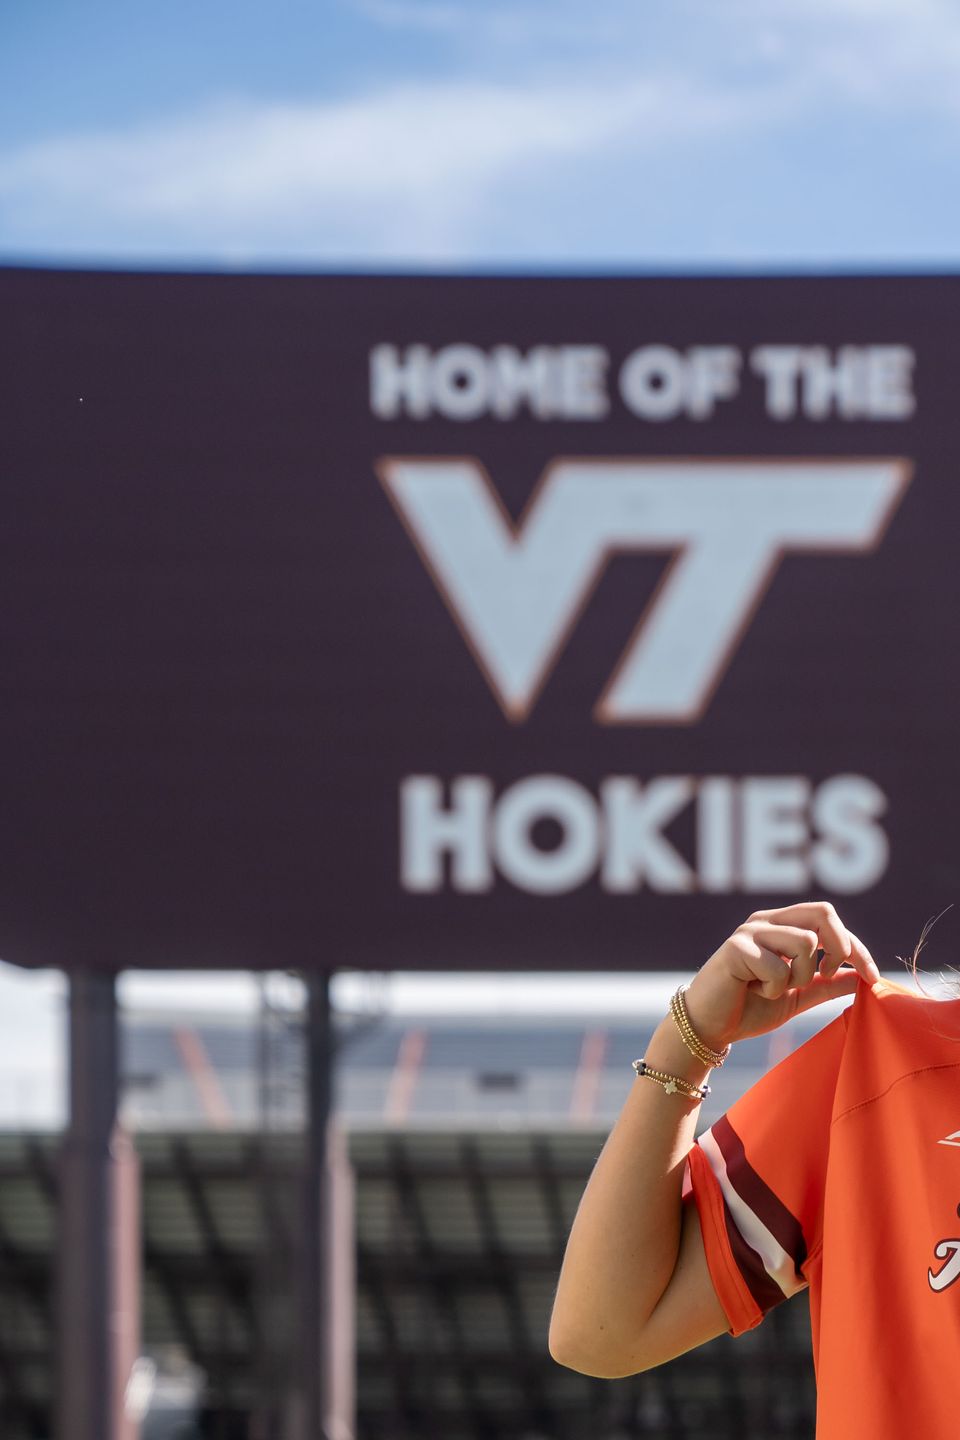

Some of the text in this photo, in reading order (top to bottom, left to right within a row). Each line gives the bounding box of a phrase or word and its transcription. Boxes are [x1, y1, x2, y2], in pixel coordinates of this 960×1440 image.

[371, 344, 915, 420] HOME OF THE
[376, 455, 914, 725] VT
[401, 774, 889, 893] HOKIES
